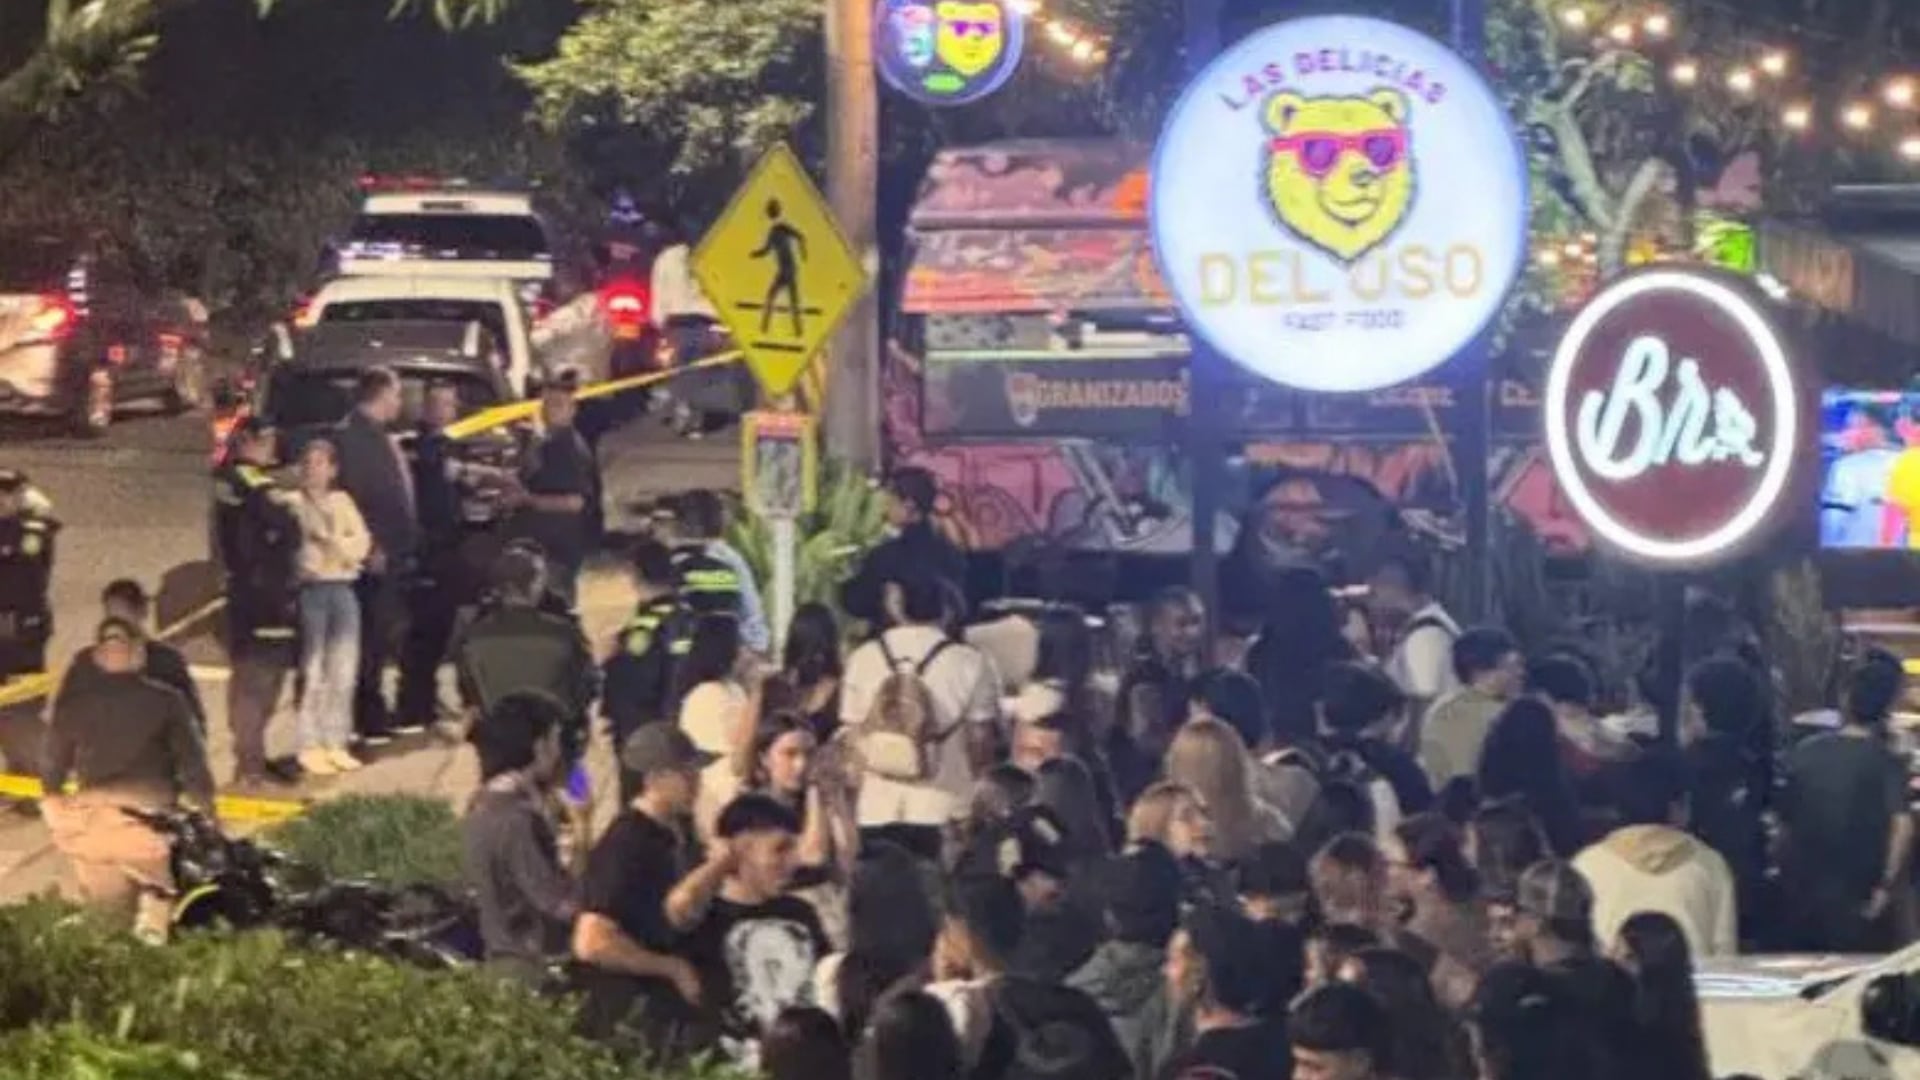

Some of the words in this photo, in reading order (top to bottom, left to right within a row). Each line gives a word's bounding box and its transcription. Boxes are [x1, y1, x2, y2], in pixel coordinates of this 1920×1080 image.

[1219, 62, 1285, 111] LAS
[1293, 48, 1448, 104] DELICIAS
[1199, 251, 1331, 307] DEL
